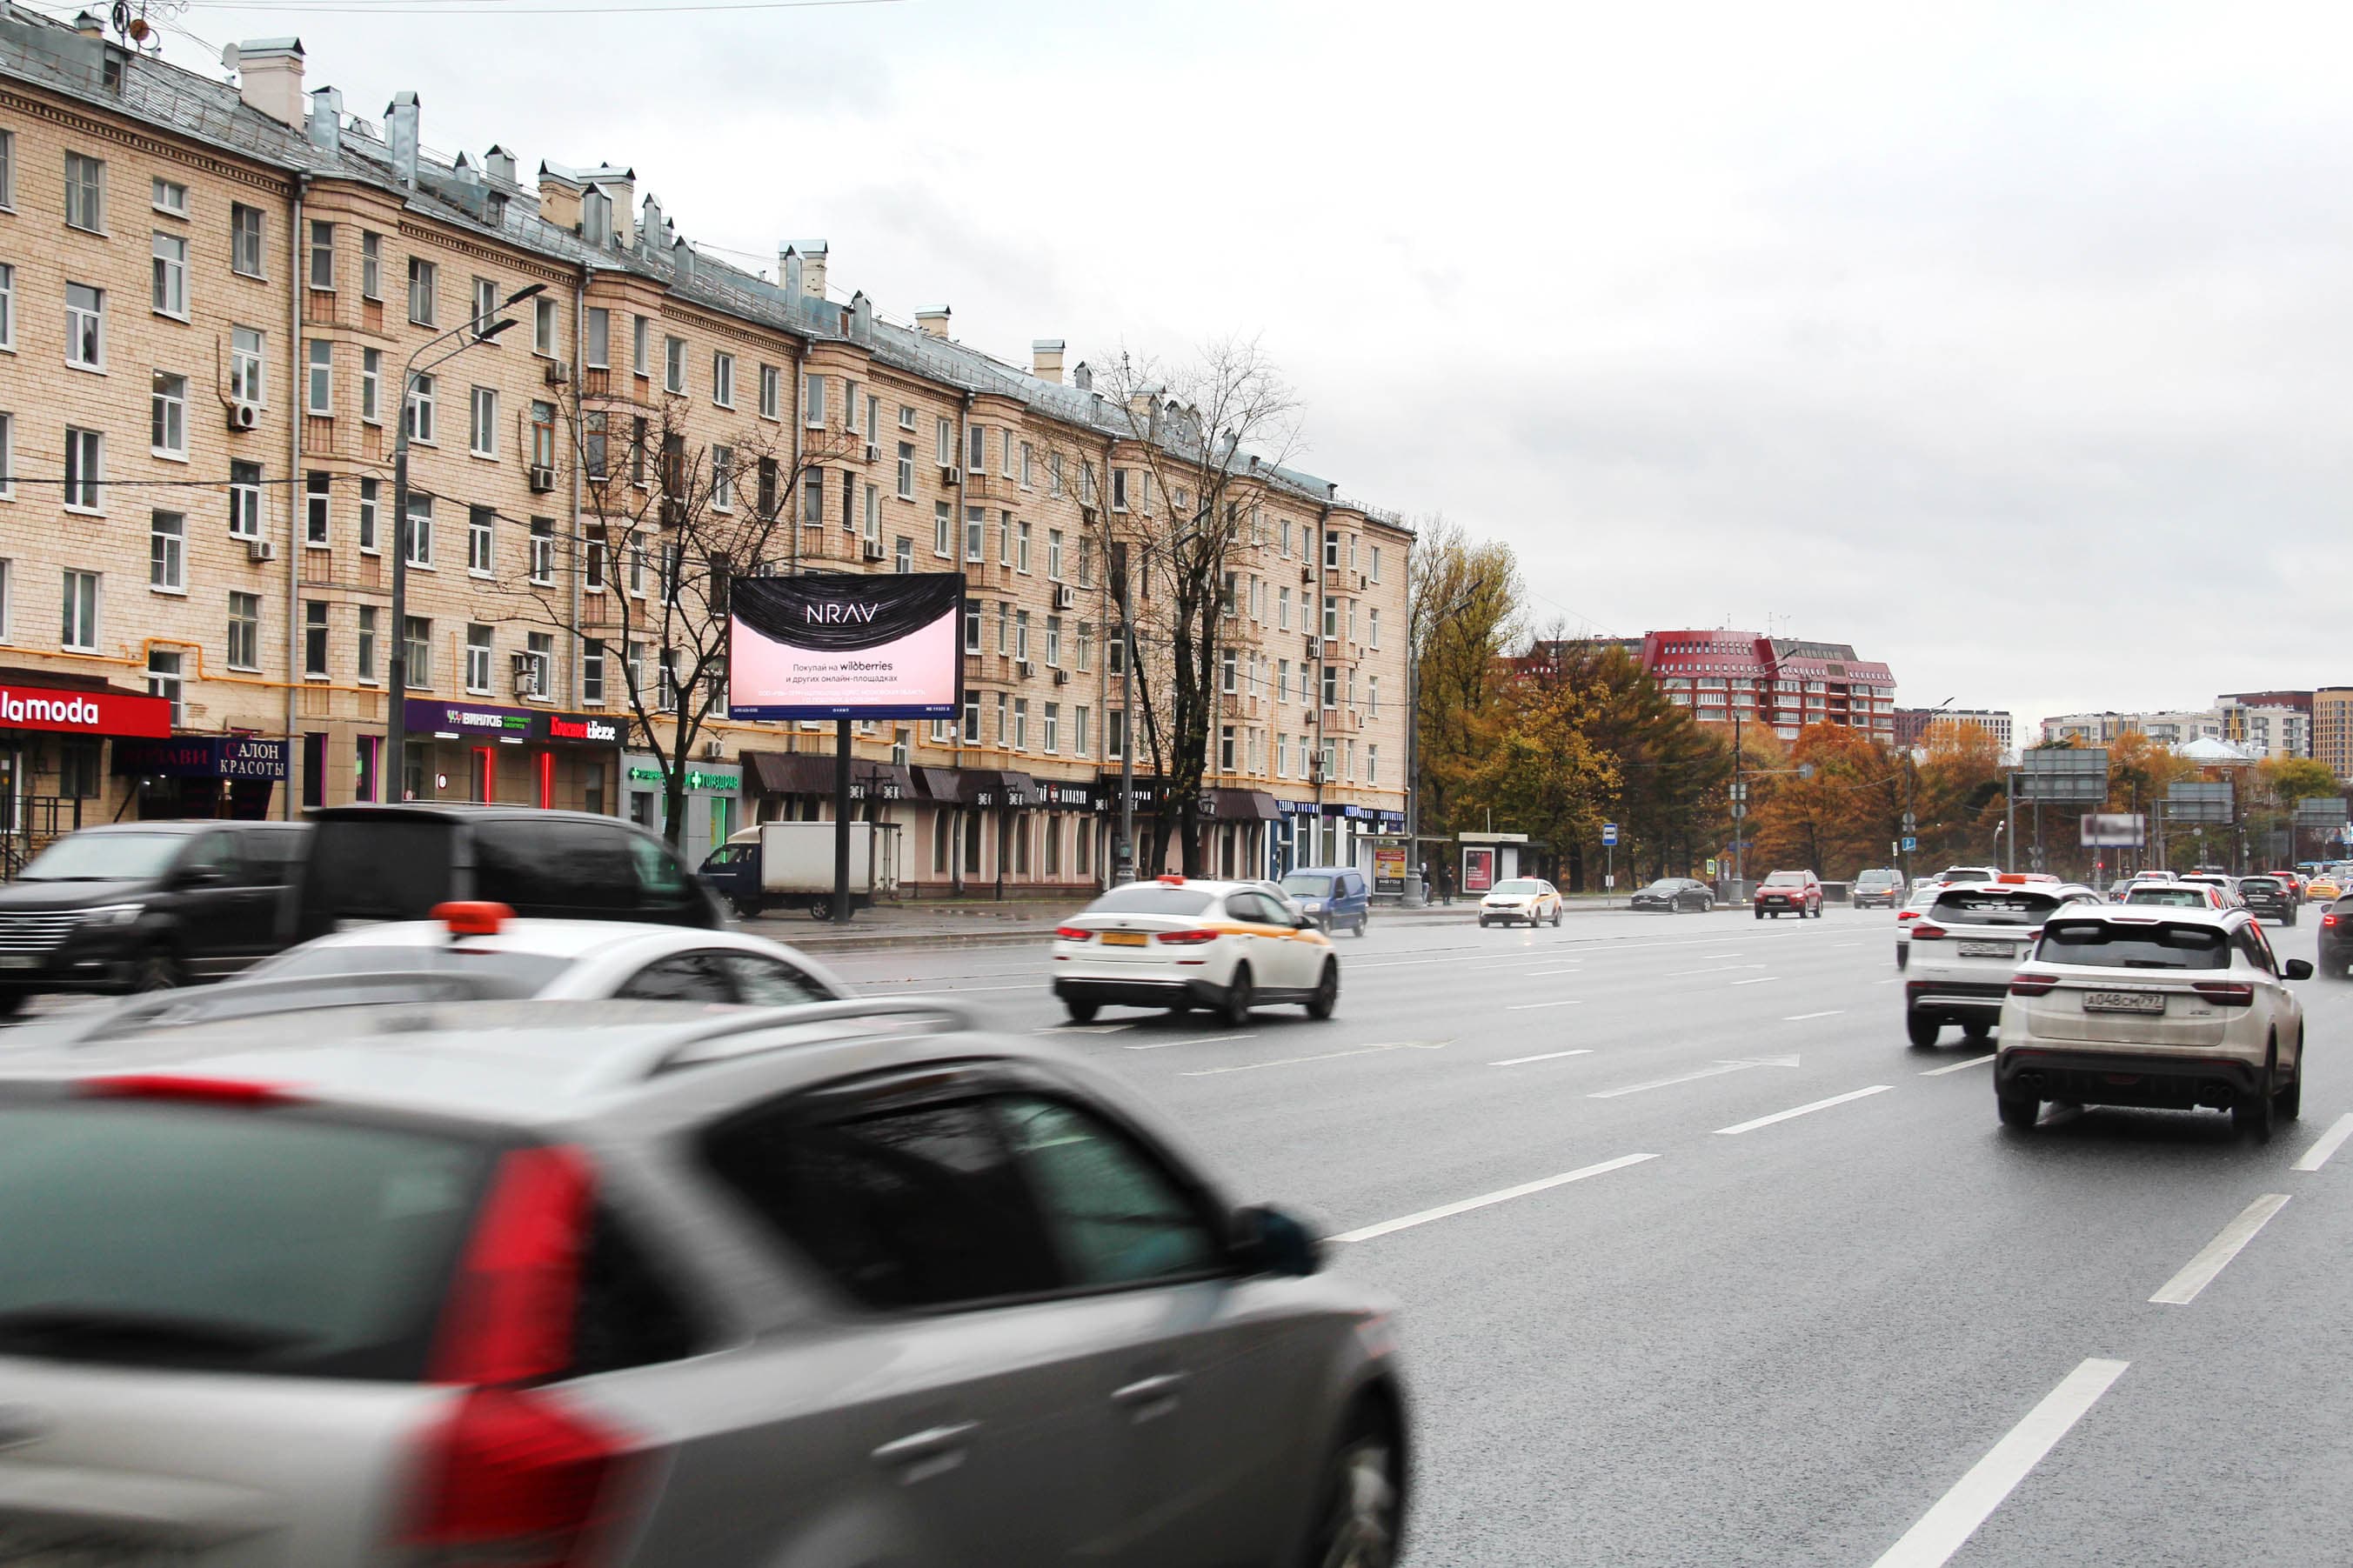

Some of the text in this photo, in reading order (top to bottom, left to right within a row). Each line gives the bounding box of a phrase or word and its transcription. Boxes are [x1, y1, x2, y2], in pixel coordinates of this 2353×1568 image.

[807, 603, 879, 624] NRAV
[793, 664, 826, 673] Покупай
[840, 661, 892, 671] wildberries
[821, 674, 898, 684] онлайн-площадках
[1, 691, 98, 724] lamoda
[462, 712, 502, 727] ВИНЛАБ
[225, 742, 279, 760] САЛОН
[220, 759, 284, 777] КРАСОТЫ
[702, 774, 739, 790] ГОРЗДРАВ
